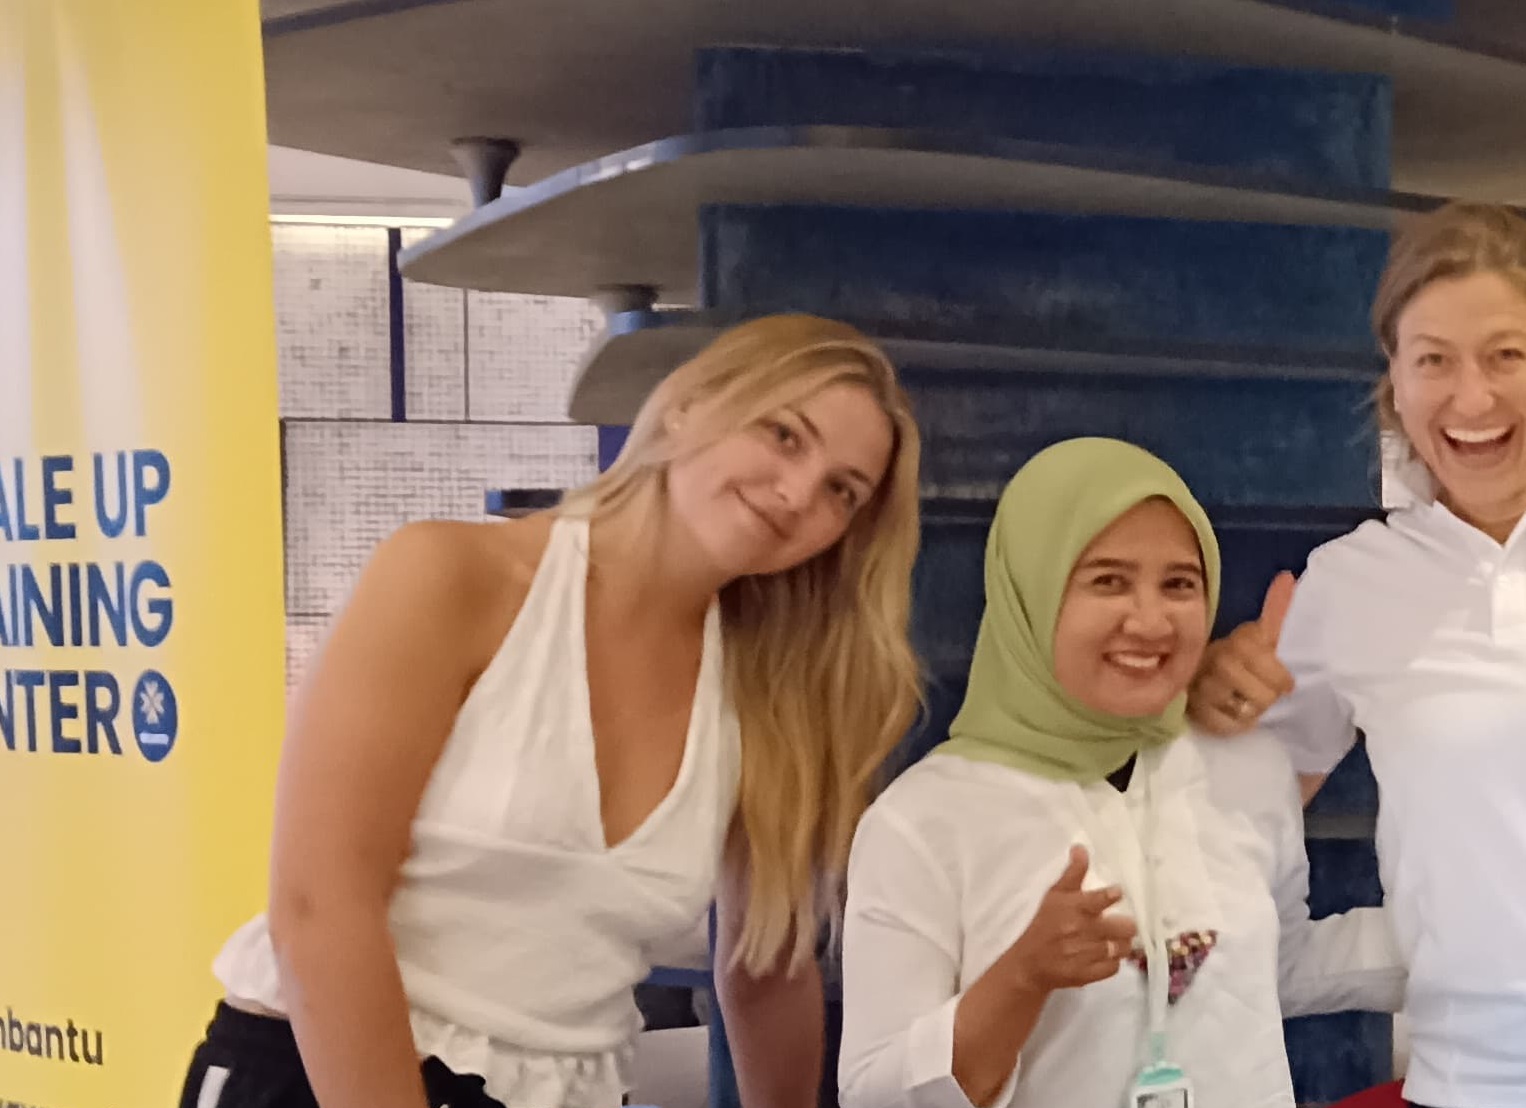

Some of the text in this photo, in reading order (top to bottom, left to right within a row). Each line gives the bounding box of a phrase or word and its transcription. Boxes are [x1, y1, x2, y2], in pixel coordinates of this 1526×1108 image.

[93, 448, 171, 538] UP
[0, 560, 174, 648] INING
[0, 1006, 104, 1066] bantu
